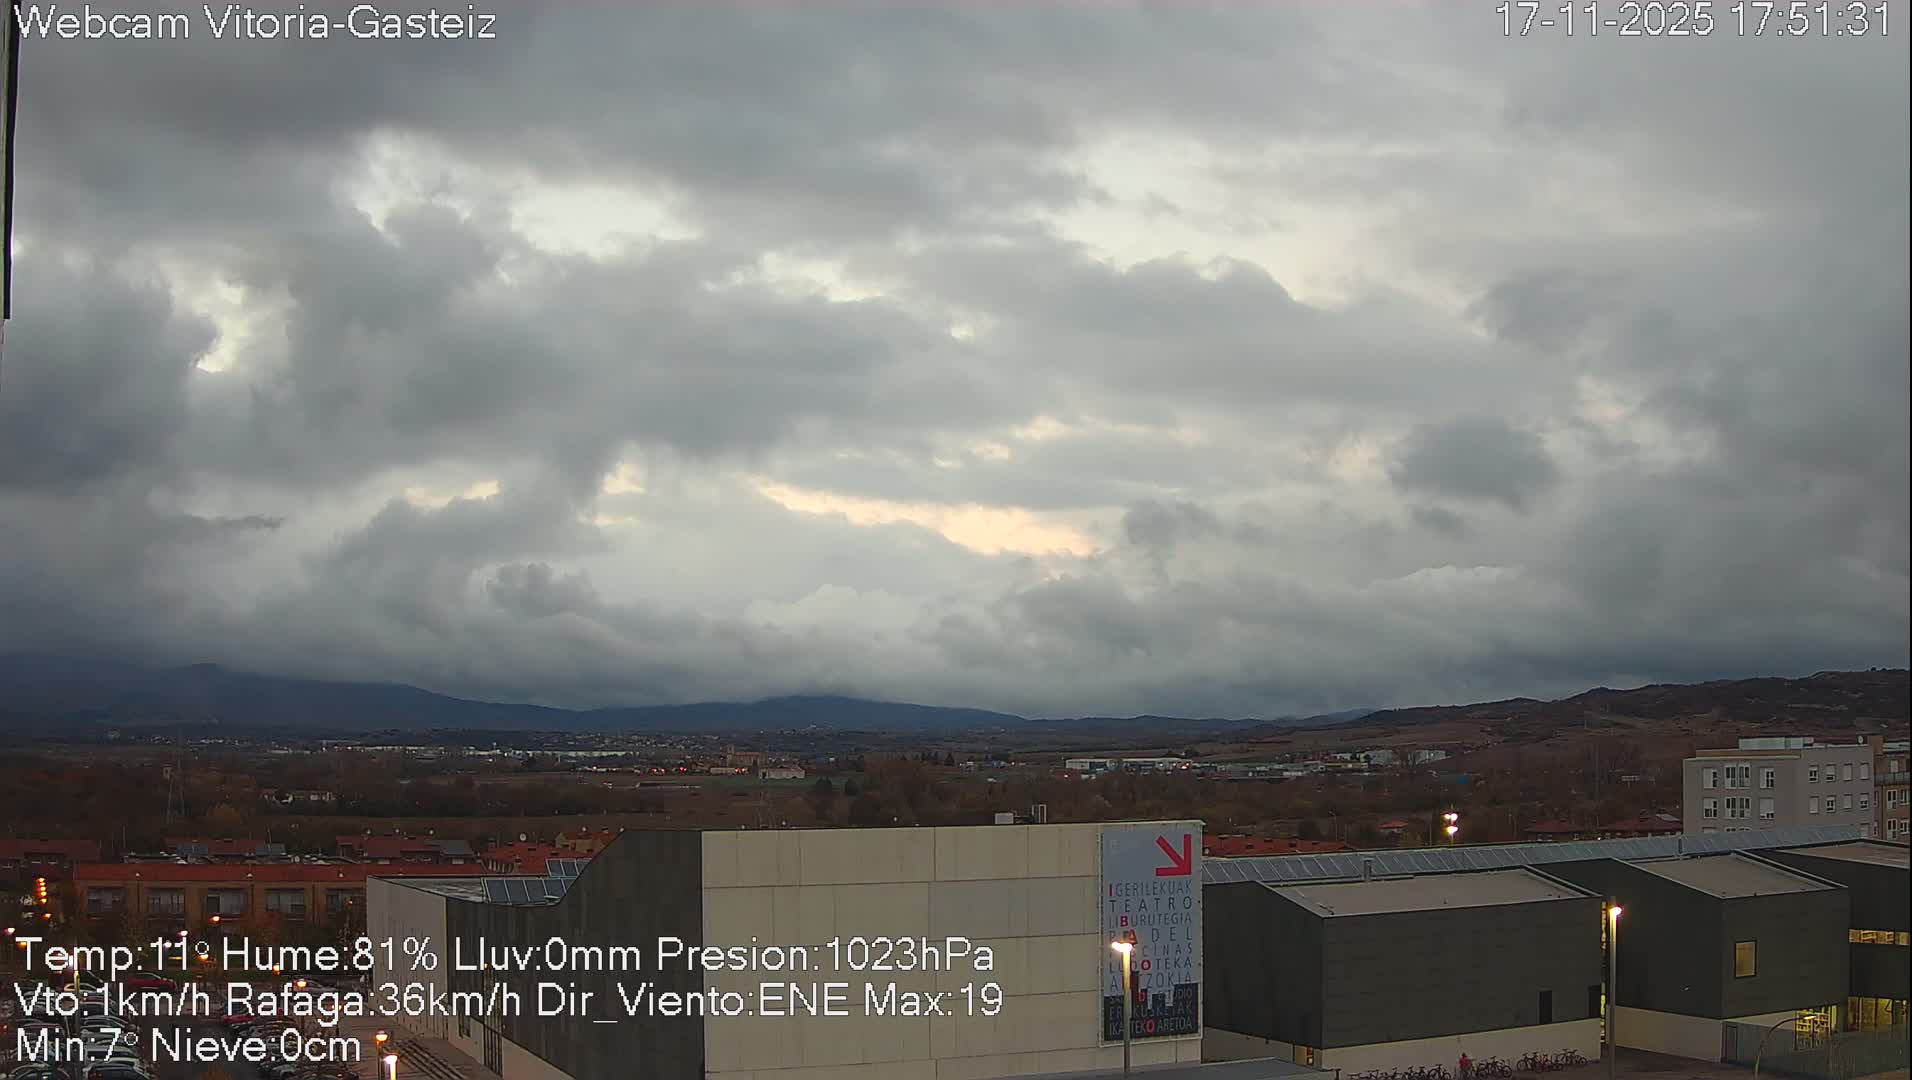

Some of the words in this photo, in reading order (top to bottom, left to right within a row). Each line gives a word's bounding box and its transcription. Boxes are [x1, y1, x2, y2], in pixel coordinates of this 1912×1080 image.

[1109, 881, 1191, 897] IGERILEKUAK
[1109, 897, 1192, 913] TEATRO
[1109, 913, 1191, 928] LIBURUTEGIA
